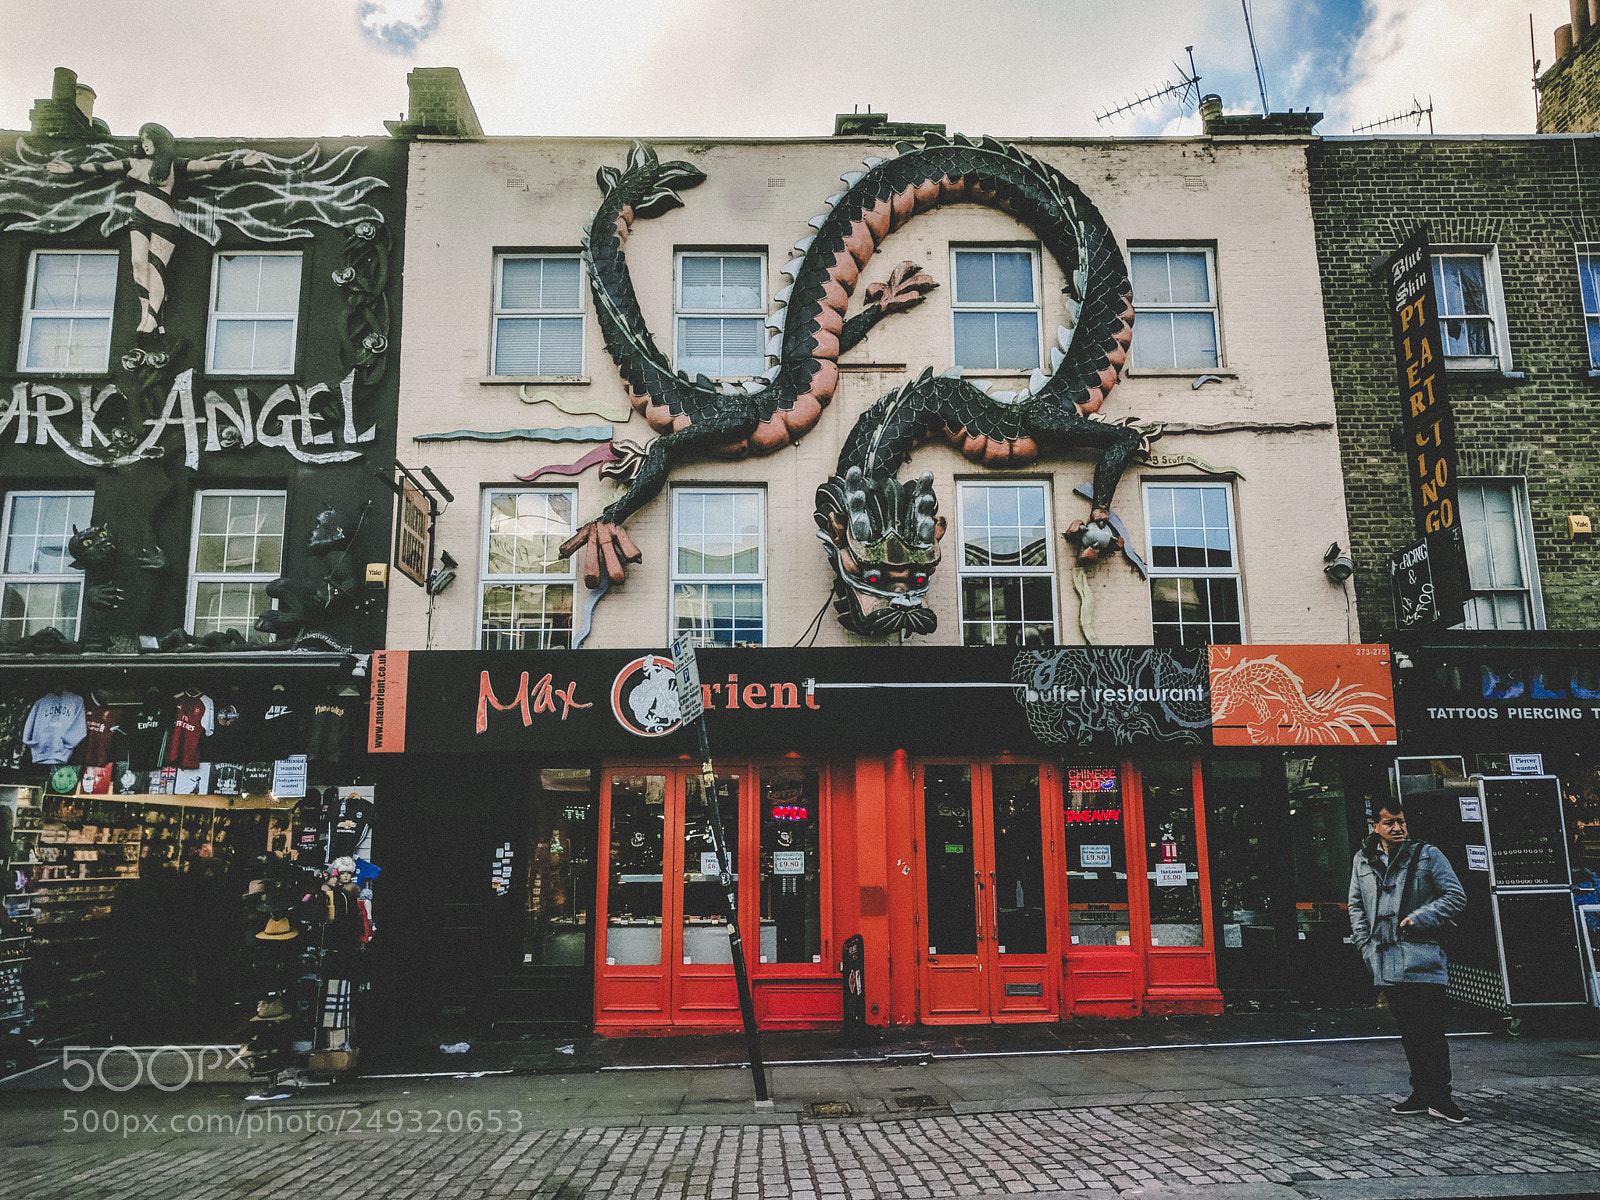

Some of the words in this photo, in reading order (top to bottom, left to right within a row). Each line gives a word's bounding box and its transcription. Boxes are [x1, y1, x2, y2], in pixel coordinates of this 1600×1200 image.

[1391, 247, 1423, 286] Blue
[1395, 272, 1427, 312] Skin
[0, 382, 164, 467] ARK
[144, 368, 376, 470] ANGEL
[374, 653, 387, 749] www.maxorient.co.uk
[1094, 684, 1204, 703] restaurant
[475, 670, 593, 735] Max
[44, 705, 72, 718] LONDON
[1427, 707, 1499, 719] TATTOOS
[1507, 707, 1583, 719] PIERCING
[1068, 768, 1117, 780] CHINESE
[1068, 779, 1102, 790] FOOD
[772, 806, 808, 820] OPEN
[1064, 809, 1121, 823] TAKEAWAY
